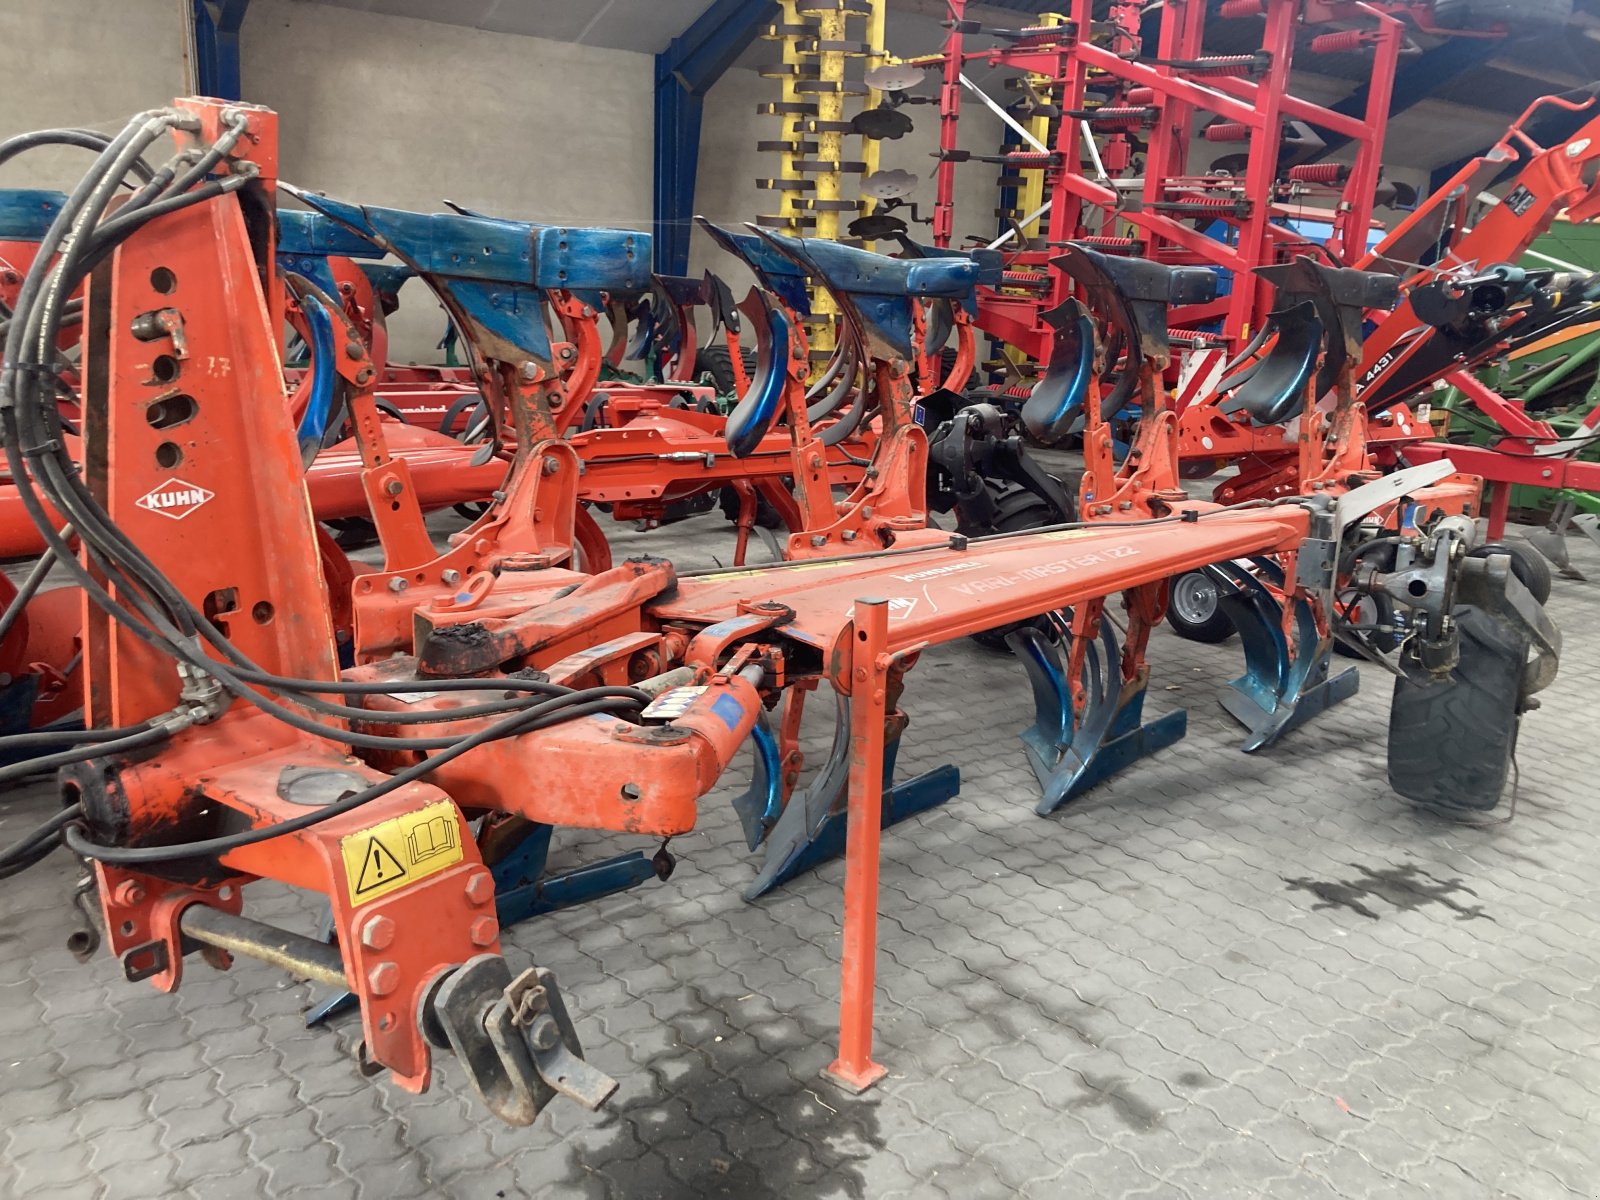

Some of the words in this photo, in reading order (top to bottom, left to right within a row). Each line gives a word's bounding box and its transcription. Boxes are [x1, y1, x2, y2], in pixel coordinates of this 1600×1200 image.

[1366, 352, 1394, 382] 4431
[147, 490, 205, 509] KUHN
[951, 554, 1106, 596] VARI-MASTER
[1101, 545, 1141, 560] 122
